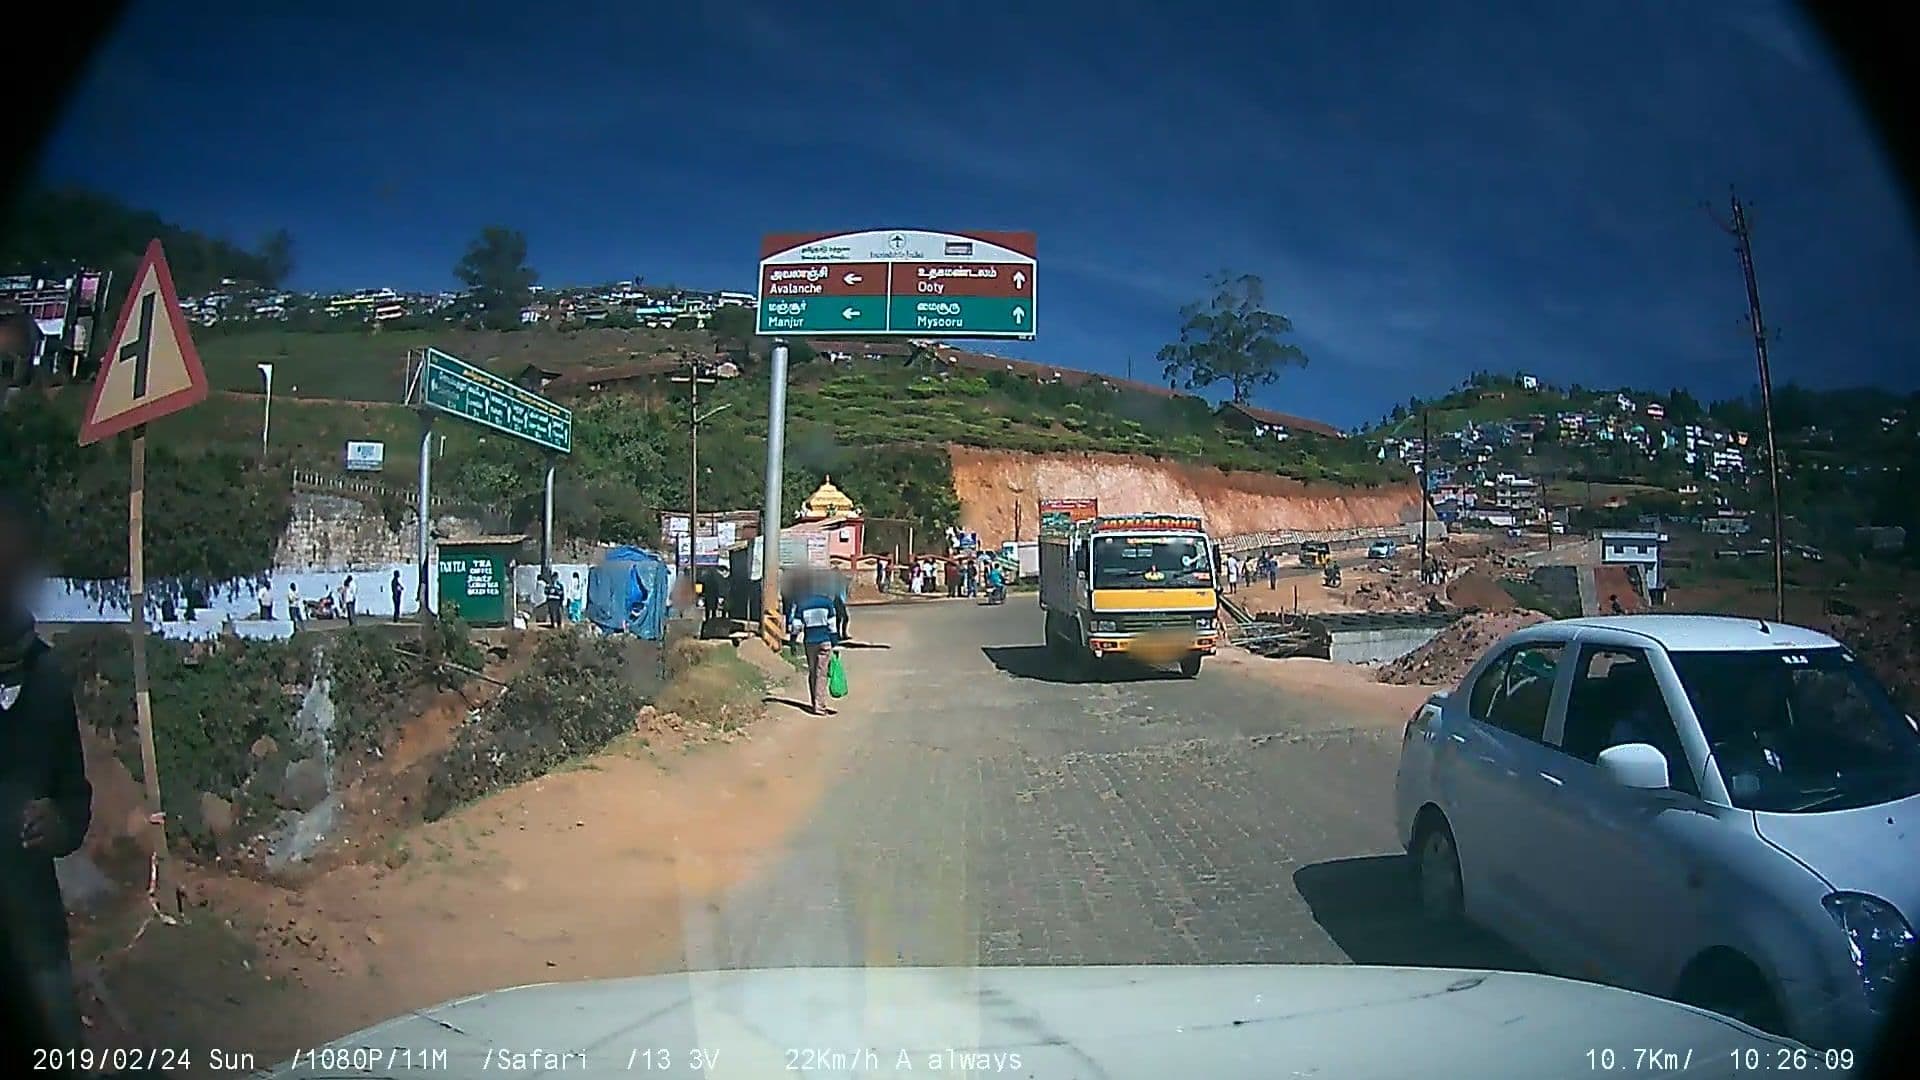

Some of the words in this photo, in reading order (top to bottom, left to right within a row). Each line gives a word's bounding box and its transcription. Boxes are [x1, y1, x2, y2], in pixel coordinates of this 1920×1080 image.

[769, 283, 822, 294] Avalanche
[918, 281, 944, 294] Ooty
[768, 316, 804, 328] Manjur
[917, 315, 963, 329] Mysooru
